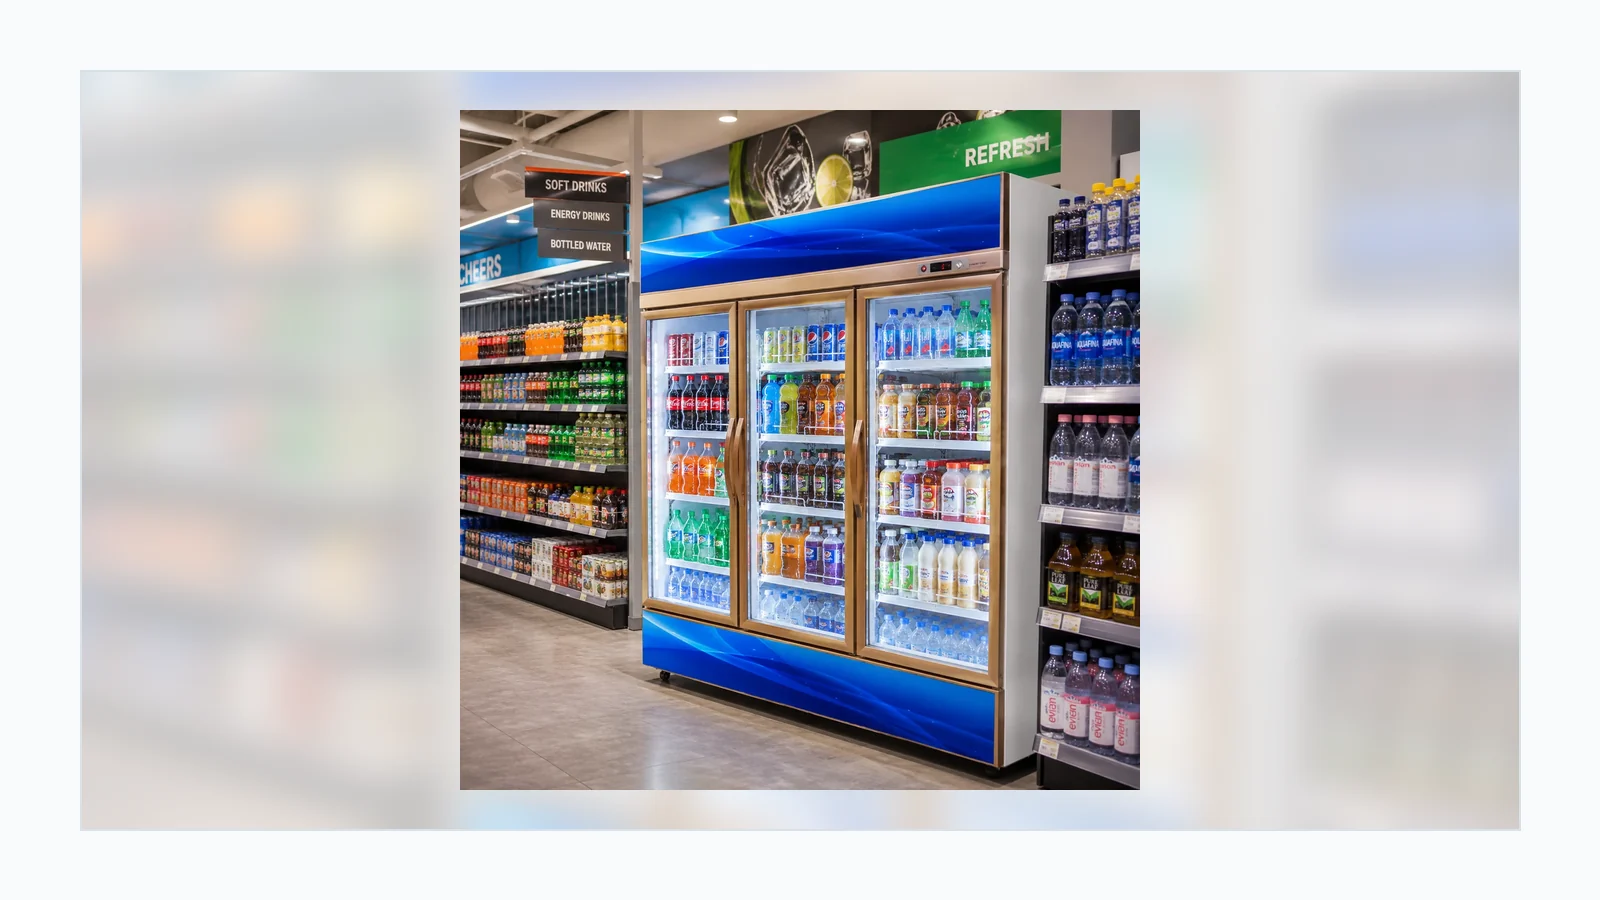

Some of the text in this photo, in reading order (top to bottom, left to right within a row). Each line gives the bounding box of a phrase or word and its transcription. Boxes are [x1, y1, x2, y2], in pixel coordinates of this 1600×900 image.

[965, 132, 1050, 167] REFRESH
[545, 179, 607, 193] SOFT DRINKS
[550, 209, 610, 222] ENERGY DRINKS
[550, 239, 612, 252] BOTTLED WATER
[460, 254, 502, 285] CHEERS
[1117, 588, 1132, 596] LEAF
[1048, 697, 1057, 723] evian
[1069, 703, 1077, 730] evian
[1094, 711, 1102, 739] evian
